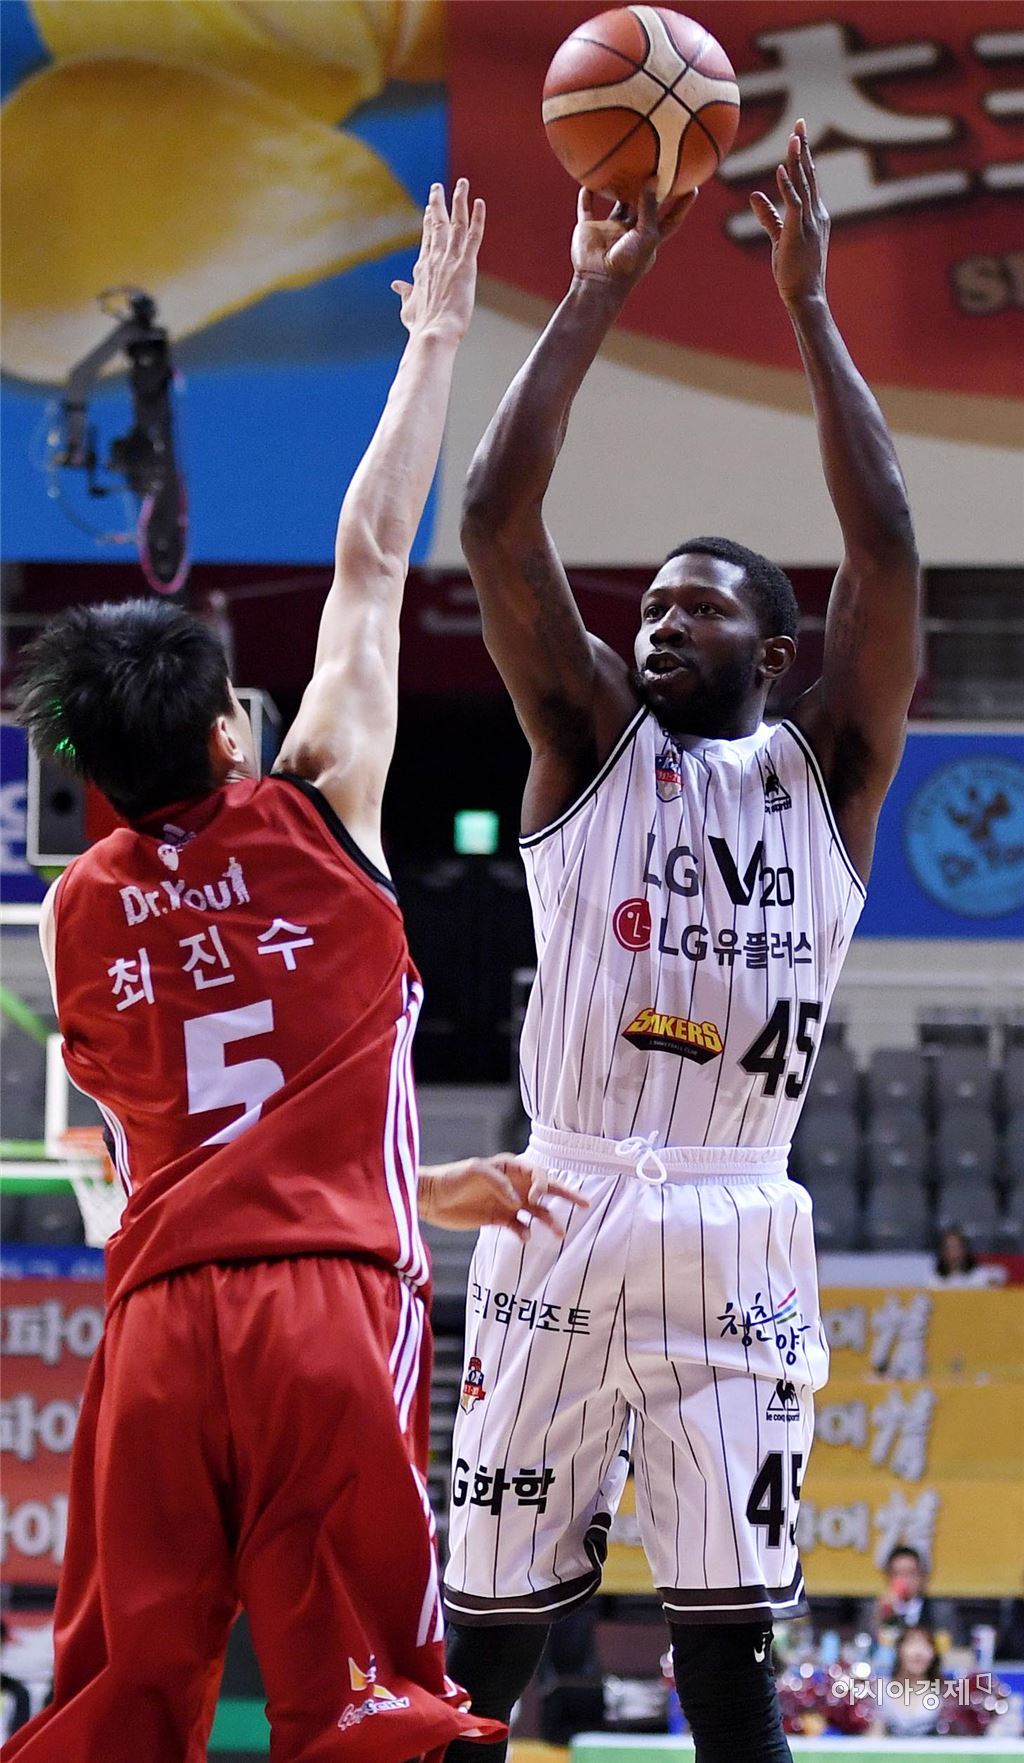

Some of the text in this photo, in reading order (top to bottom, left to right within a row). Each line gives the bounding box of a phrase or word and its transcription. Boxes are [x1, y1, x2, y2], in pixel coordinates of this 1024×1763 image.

[642, 832, 700, 897] LG
[119, 878, 232, 927] Dr.You
[657, 916, 813, 969] LG유플러스
[183, 998, 286, 1147] 5
[737, 997, 823, 1101] 45
[452, 1457, 556, 1516] G화학
